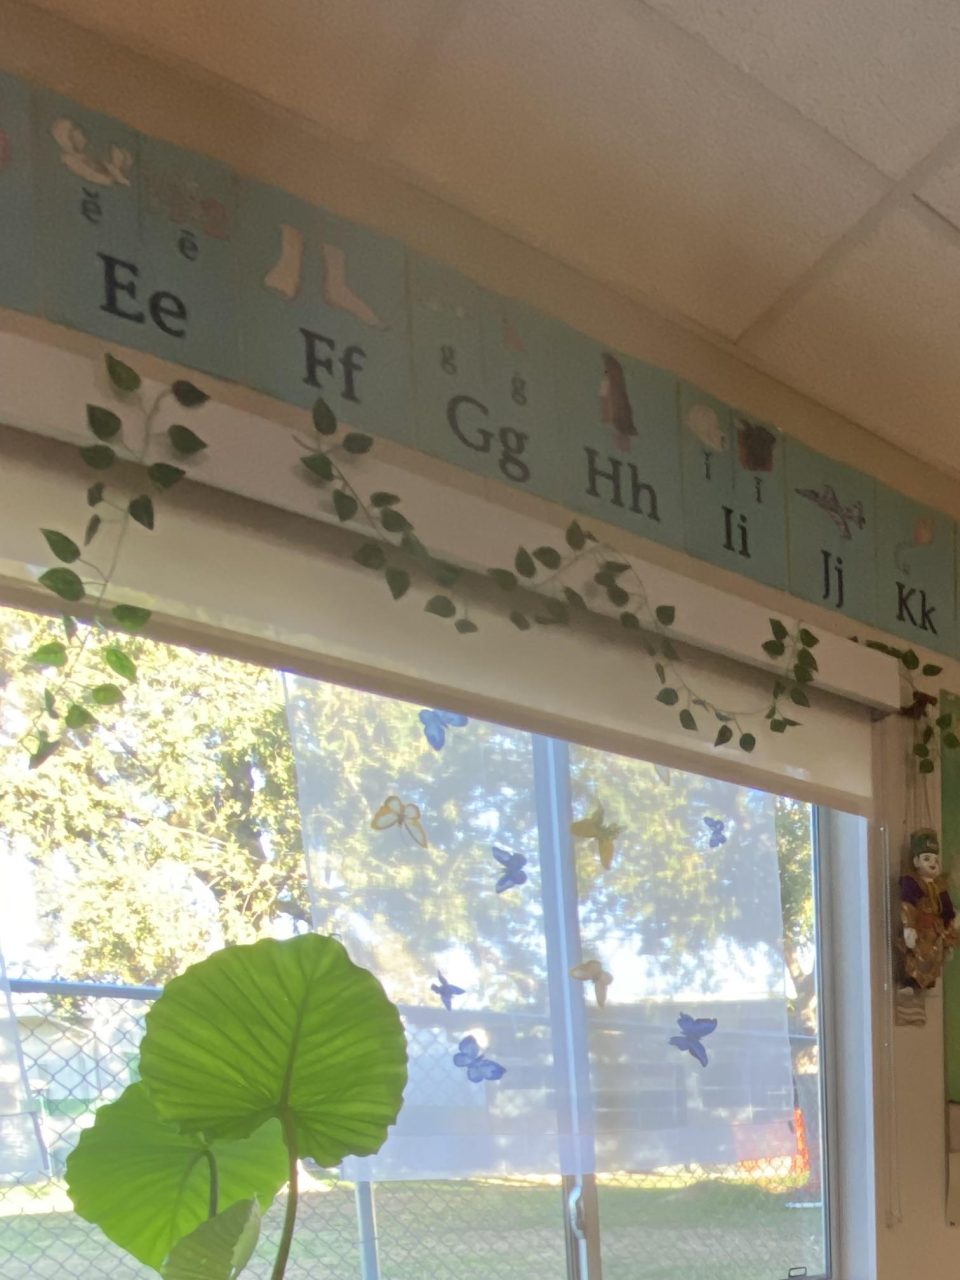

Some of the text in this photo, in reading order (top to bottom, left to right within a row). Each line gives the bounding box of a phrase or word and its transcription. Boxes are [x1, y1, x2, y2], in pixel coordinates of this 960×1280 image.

[97, 252, 188, 338] Ee
[300, 328, 366, 403] Ff
[446, 395, 530, 482] Gg
[585, 448, 661, 522] Hh
[721, 506, 752, 559] Ii
[821, 549, 846, 609] Jj
[895, 582, 938, 635] Kk
